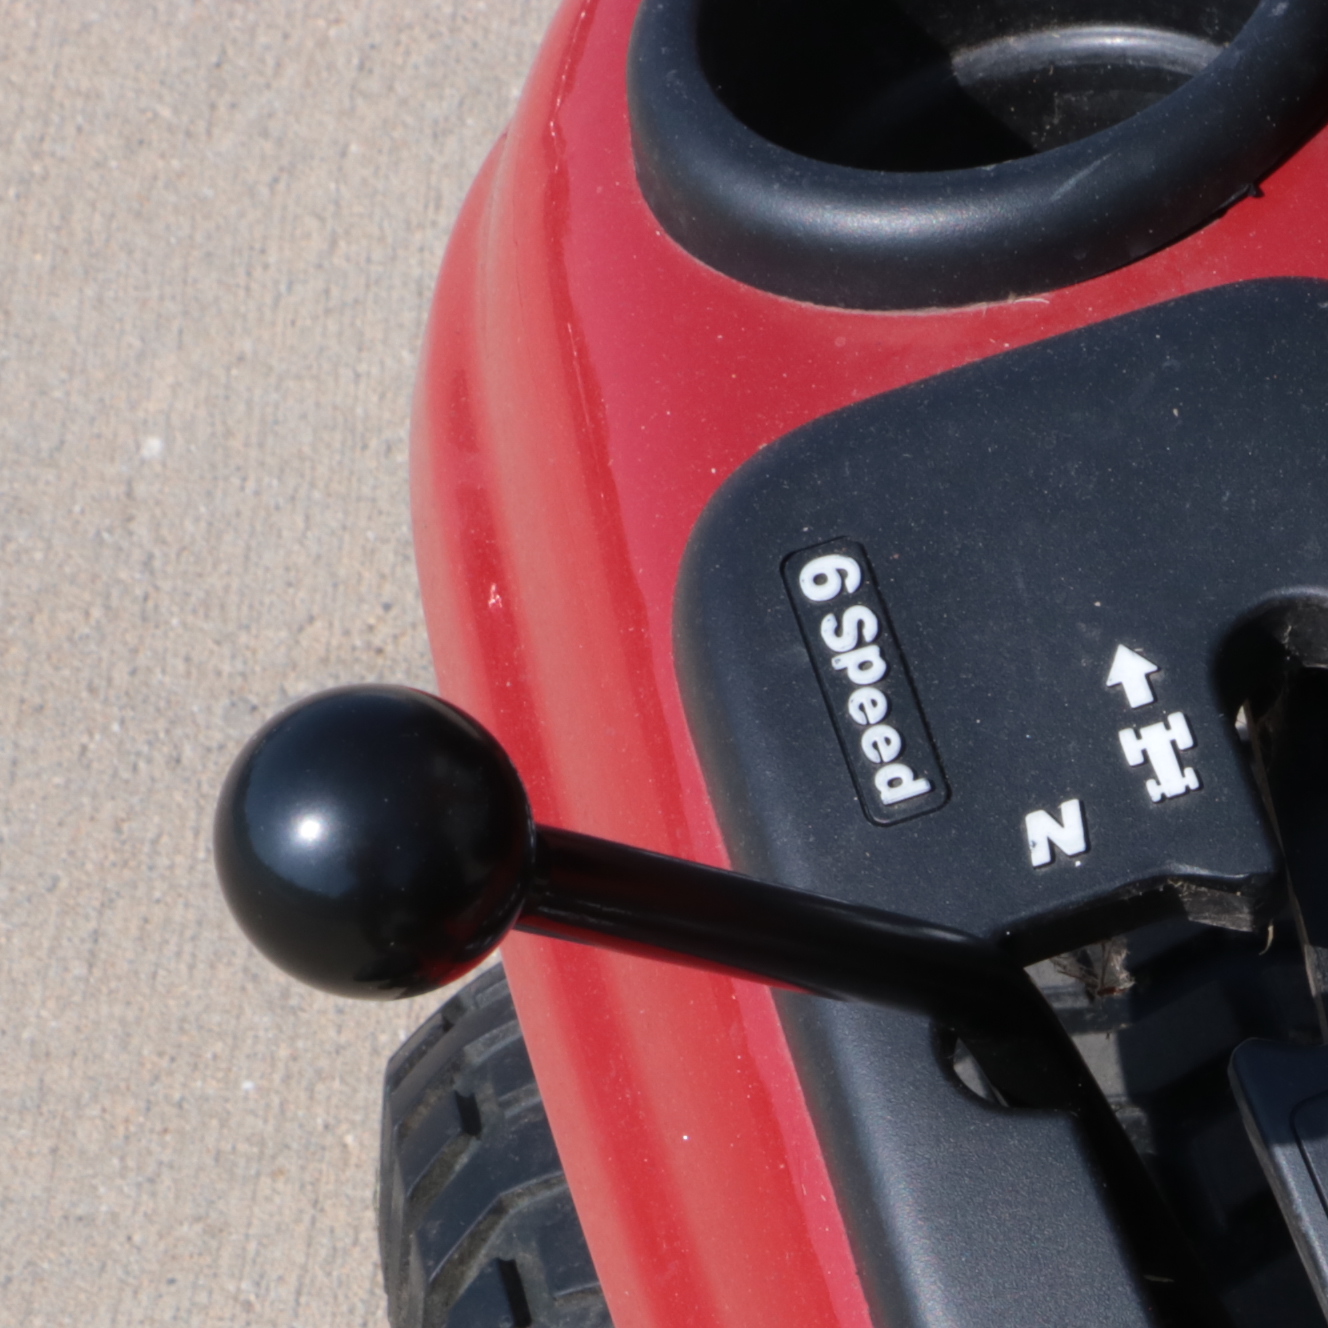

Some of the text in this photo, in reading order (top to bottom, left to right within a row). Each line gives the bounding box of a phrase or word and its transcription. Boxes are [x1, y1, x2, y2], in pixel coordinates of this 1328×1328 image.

[799, 554, 931, 806] 6 Speed
[1024, 798, 1088, 869] N
